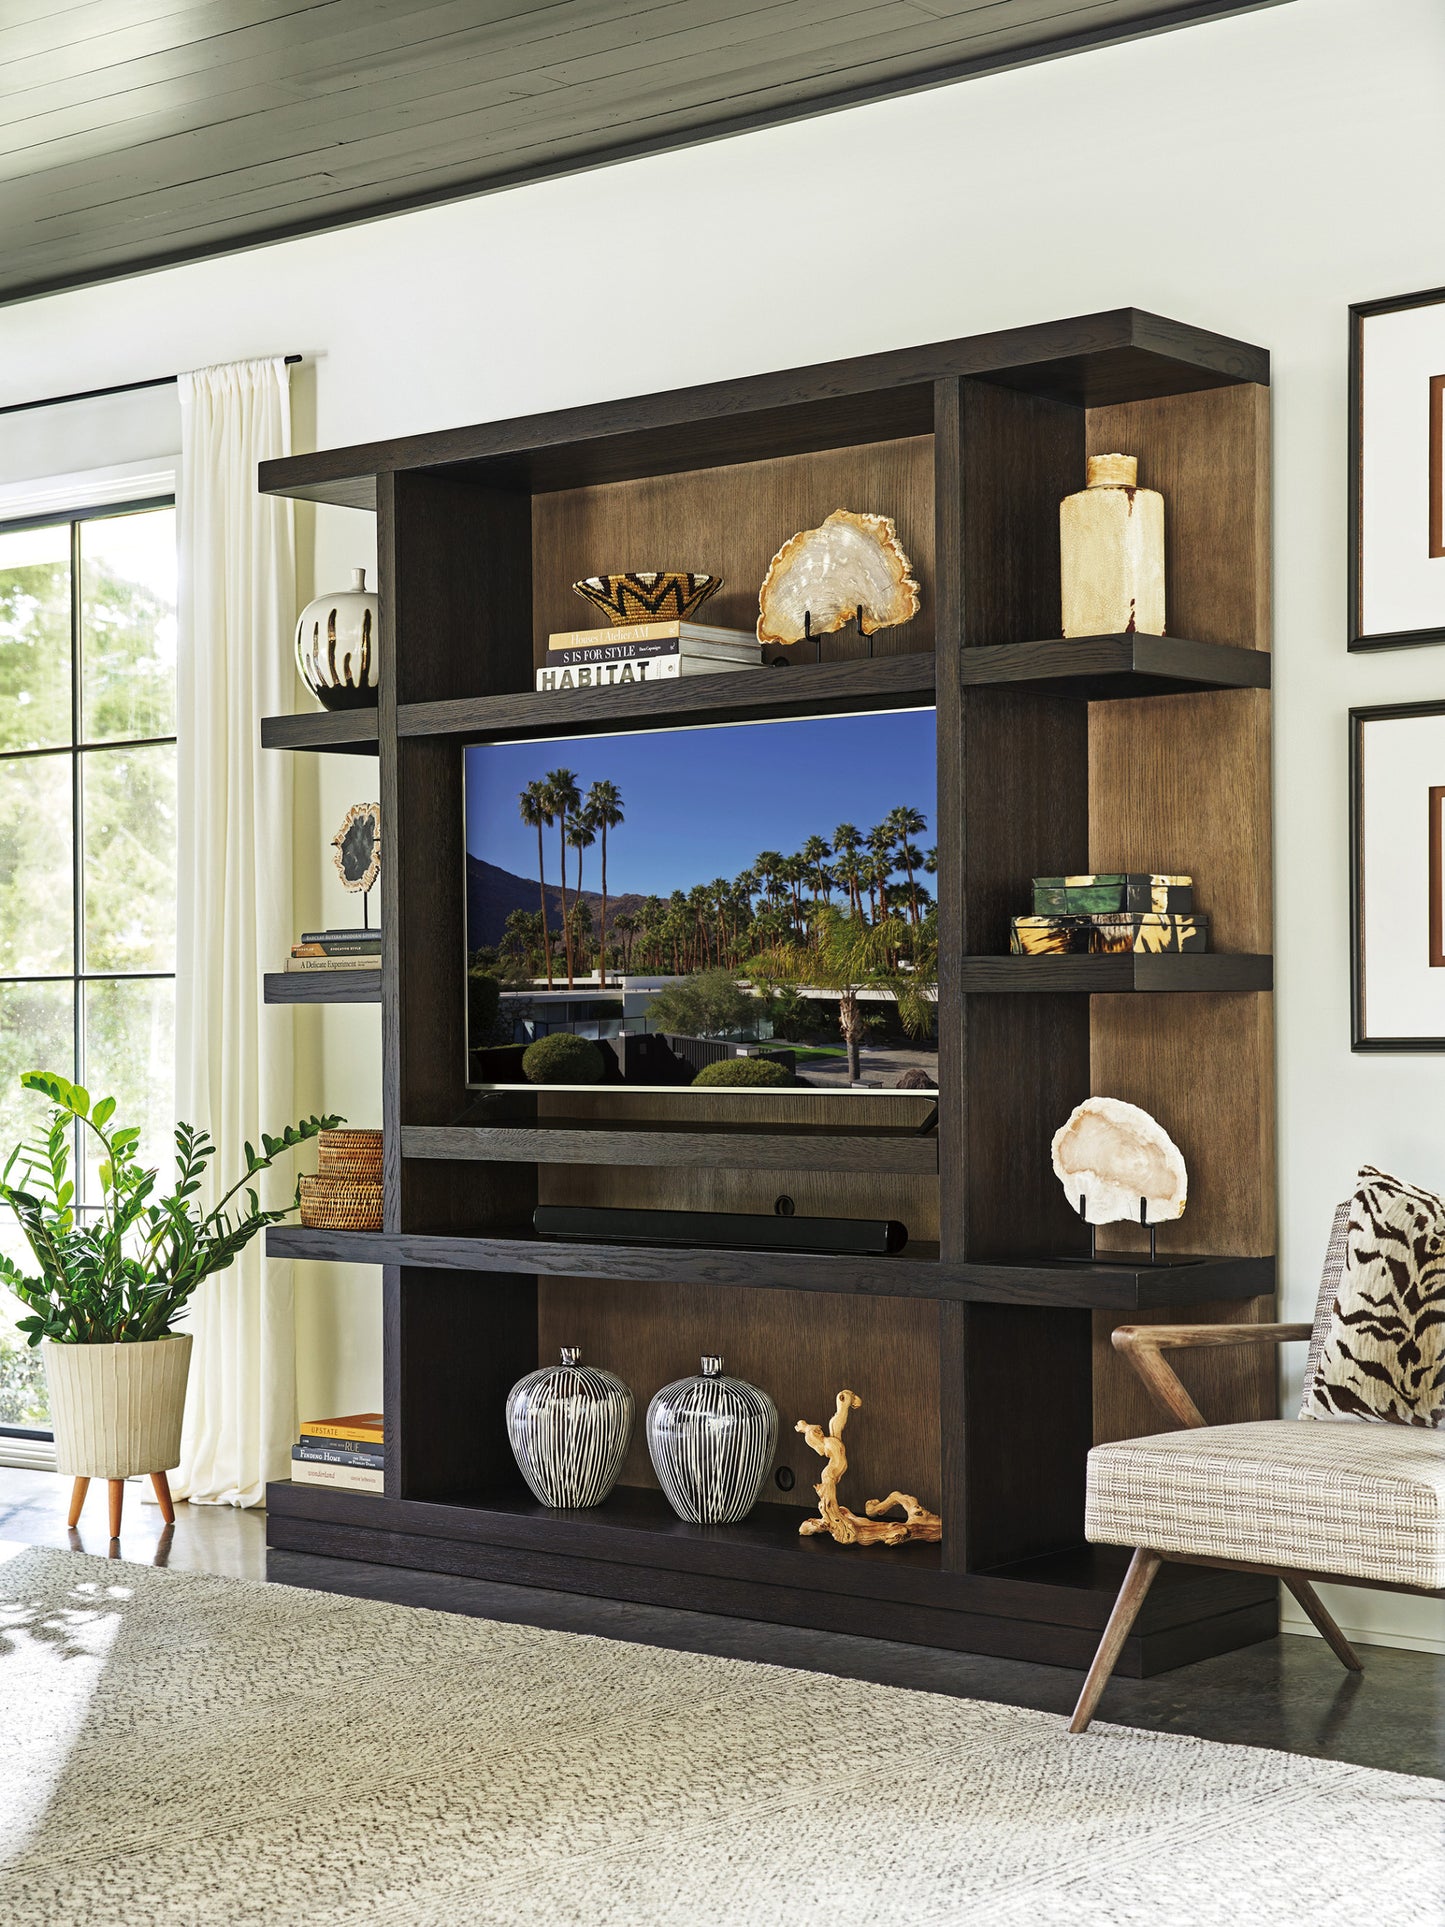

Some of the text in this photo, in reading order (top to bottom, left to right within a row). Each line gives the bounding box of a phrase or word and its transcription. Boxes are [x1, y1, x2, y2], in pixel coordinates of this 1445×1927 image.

[633, 626, 649, 640] AM
[563, 645, 636, 663] S IS FOR STYLE
[542, 661, 650, 691] HABITAT
[301, 961, 306, 969] A
[306, 961, 327, 969] Delicate
[327, 960, 357, 970] Experiment
[311, 1427, 338, 1436] UPSTATE
